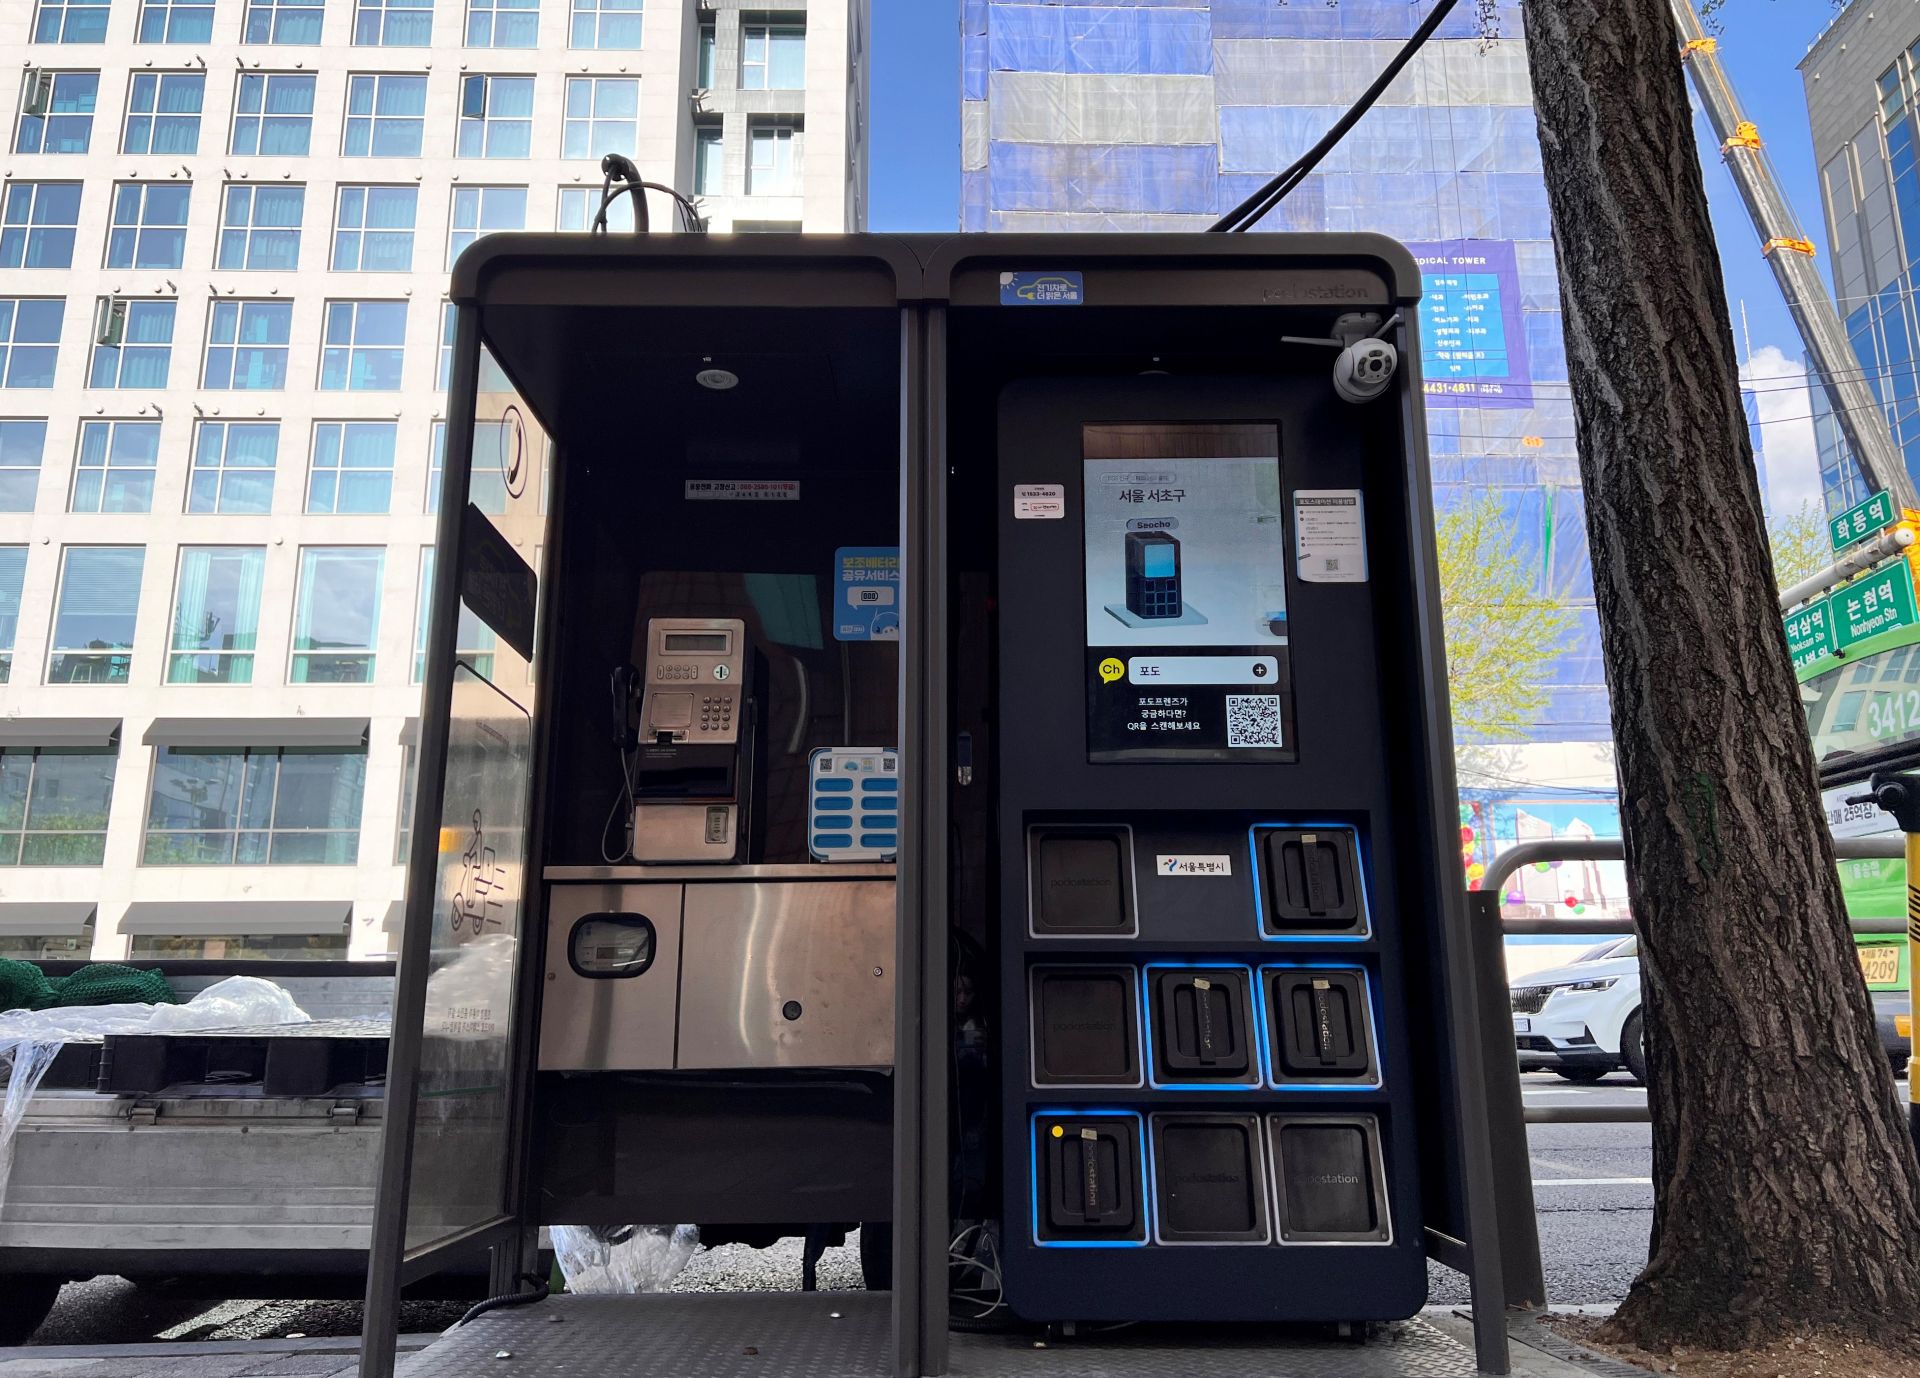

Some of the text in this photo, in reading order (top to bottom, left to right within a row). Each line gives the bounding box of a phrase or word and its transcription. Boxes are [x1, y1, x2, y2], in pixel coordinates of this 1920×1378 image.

[1452, 257, 1486, 265] TOWER
[1036, 283, 1068, 292] 전기차로
[1263, 283, 1369, 302] podstation
[1036, 292, 1045, 300] 더
[1063, 292, 1078, 300] 서울
[1119, 489, 1186, 503] 서울 서초구
[1137, 520, 1171, 529] Seocho
[1836, 499, 1884, 540] 학동역
[842, 570, 900, 581] 공유서비스
[1846, 579, 1894, 621] 논현역
[1787, 609, 1824, 640] 역삼역
[1850, 607, 1898, 638] Nonhyeon Stn
[1814, 632, 1825, 644] Stn
[1102, 664, 1120, 675] Ch
[1139, 666, 1161, 676] 포도
[1138, 697, 1189, 707] 포도프렌즈가
[1141, 710, 1186, 718] 궁금하다면?
[1868, 690, 1920, 737] 3412
[1127, 721, 1201, 731] QR을 스캔해보세요
[1178, 862, 1224, 873] 서울특별시
[1877, 949, 1888, 958] 74
[1864, 960, 1895, 980] 4209
